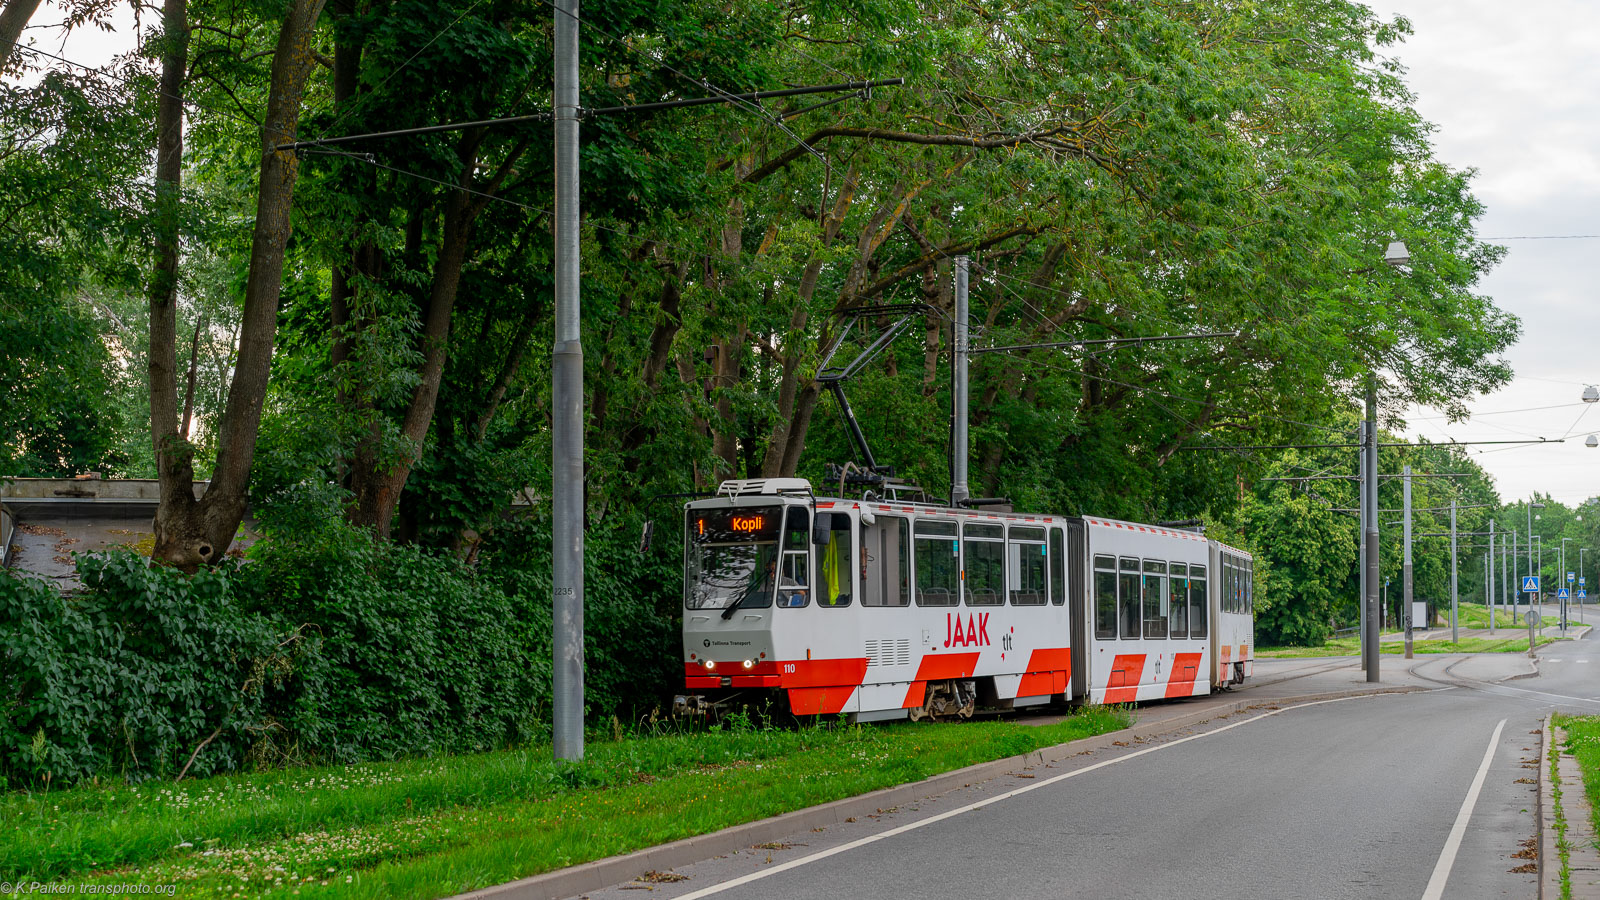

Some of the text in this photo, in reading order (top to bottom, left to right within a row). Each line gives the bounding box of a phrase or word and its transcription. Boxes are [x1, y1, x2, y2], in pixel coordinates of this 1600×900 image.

[698, 516, 761, 535] 1 Kopli
[554, 587, 573, 596] 2235
[944, 612, 990, 648] JAAK
[784, 663, 796, 673] 110
